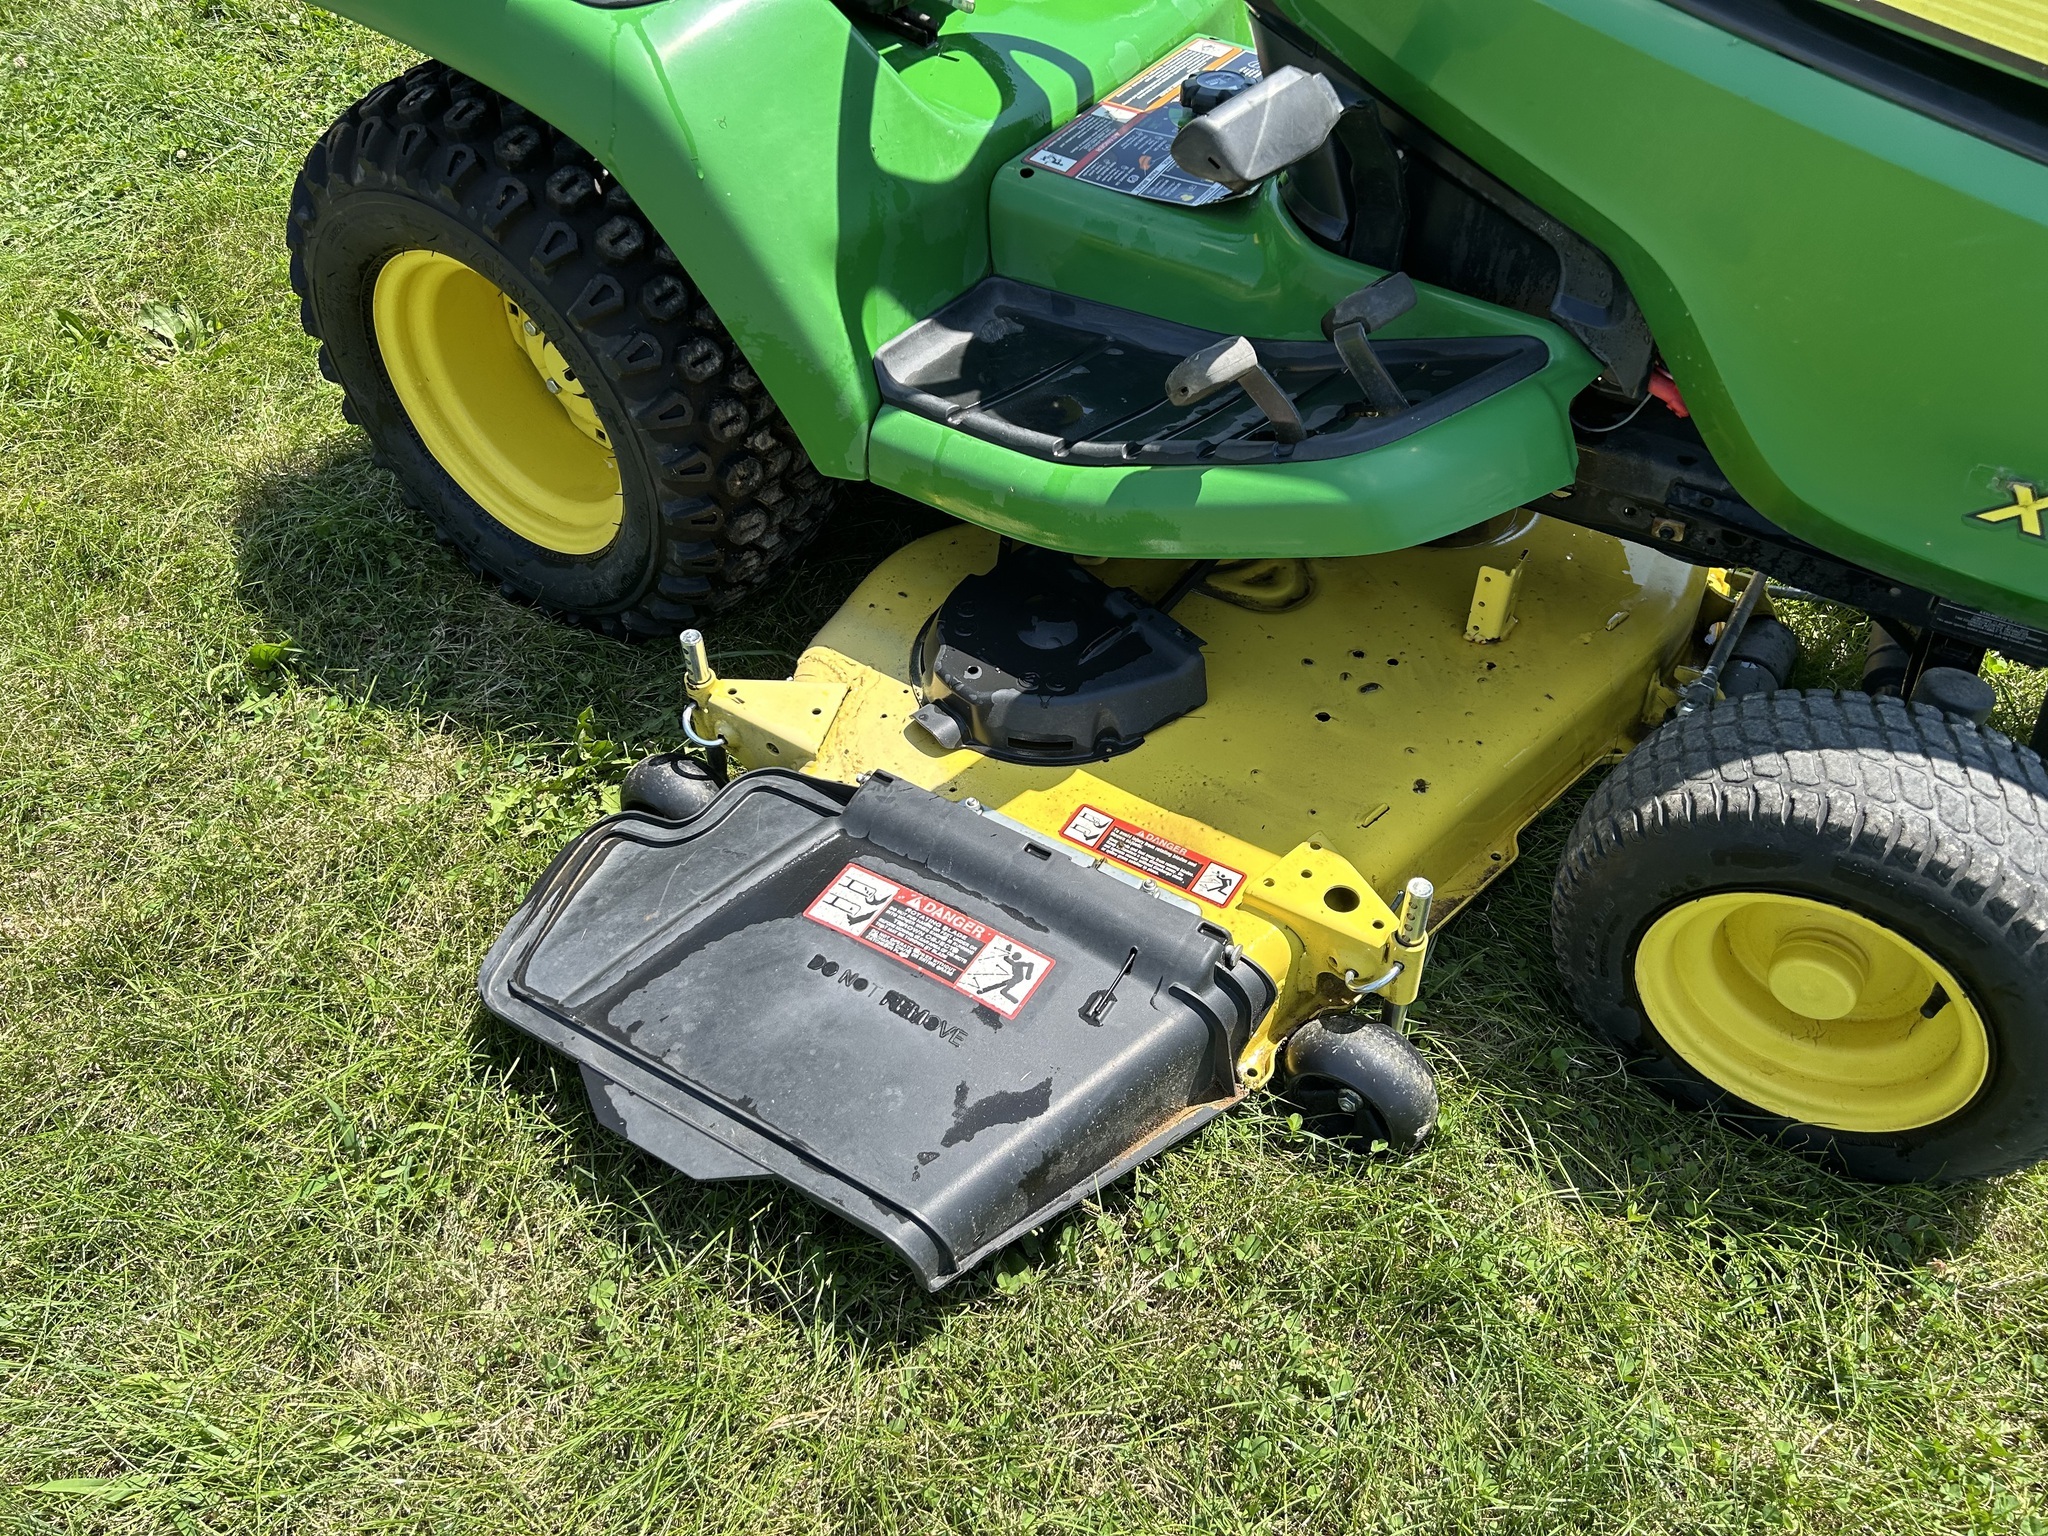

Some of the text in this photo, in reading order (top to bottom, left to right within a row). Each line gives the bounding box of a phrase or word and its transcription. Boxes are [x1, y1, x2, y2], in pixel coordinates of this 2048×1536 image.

[1130, 835, 1145, 845] injury
[1143, 841, 1155, 849] from
[1153, 846, 1173, 857] rotating
[1171, 853, 1188, 863] blades
[1144, 833, 1188, 855] DANGER
[892, 918, 960, 953] THROWN OBJECTS
[904, 907, 968, 940] ROTATING BLADE
[921, 901, 986, 937] DANGER
[951, 936, 969, 947] UNDER
[807, 953, 969, 1048] DO NOT REMOVE
